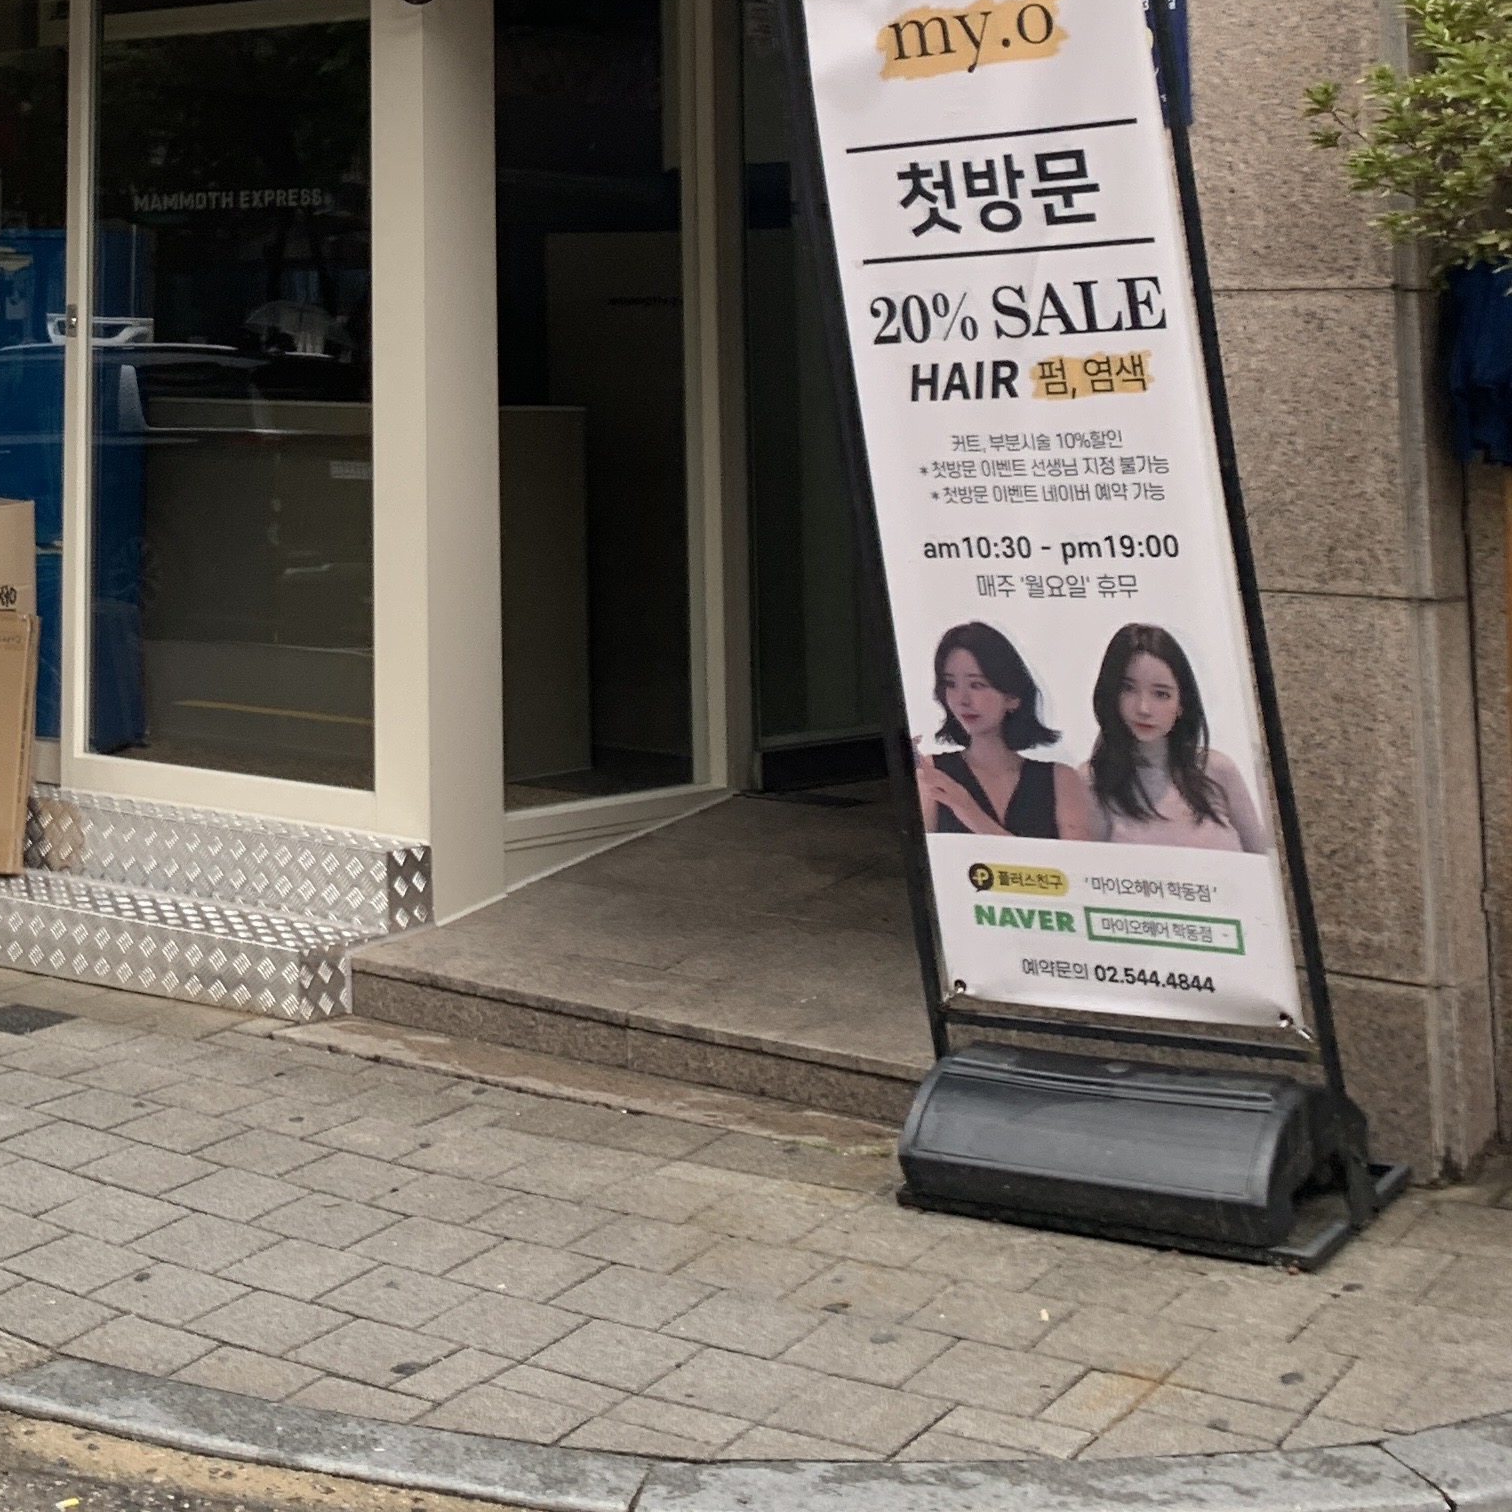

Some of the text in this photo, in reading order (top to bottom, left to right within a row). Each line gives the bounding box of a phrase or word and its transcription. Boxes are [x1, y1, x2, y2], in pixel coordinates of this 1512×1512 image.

[887, 2, 1055, 73] my.o
[132, 187, 322, 211] MAMMOTH EXPRESS
[896, 148, 1101, 237] 첫방문
[870, 276, 1168, 345] 20% SALE
[910, 353, 1148, 402] HAIR 펌, 염색
[989, 433, 1052, 452] 부분시술
[1055, 429, 1123, 450] 10%할인
[931, 455, 1170, 479] 첫방문 이벤트 선생님 지정 불가능
[942, 482, 1166, 504] 첫방문 이벤트 네이버 예약 가능
[923, 535, 1032, 559] am10:30
[1060, 534, 1180, 565] pm19:00
[976, 574, 1016, 598] 매주
[1096, 573, 1140, 599] 휴무
[997, 871, 1064, 890] 플러스친구
[973, 904, 1077, 933] NAVER
[1101, 917, 1213, 944] 마이오헤어 학동점
[1021, 958, 1217, 994] 예약문의 02.544.4844
